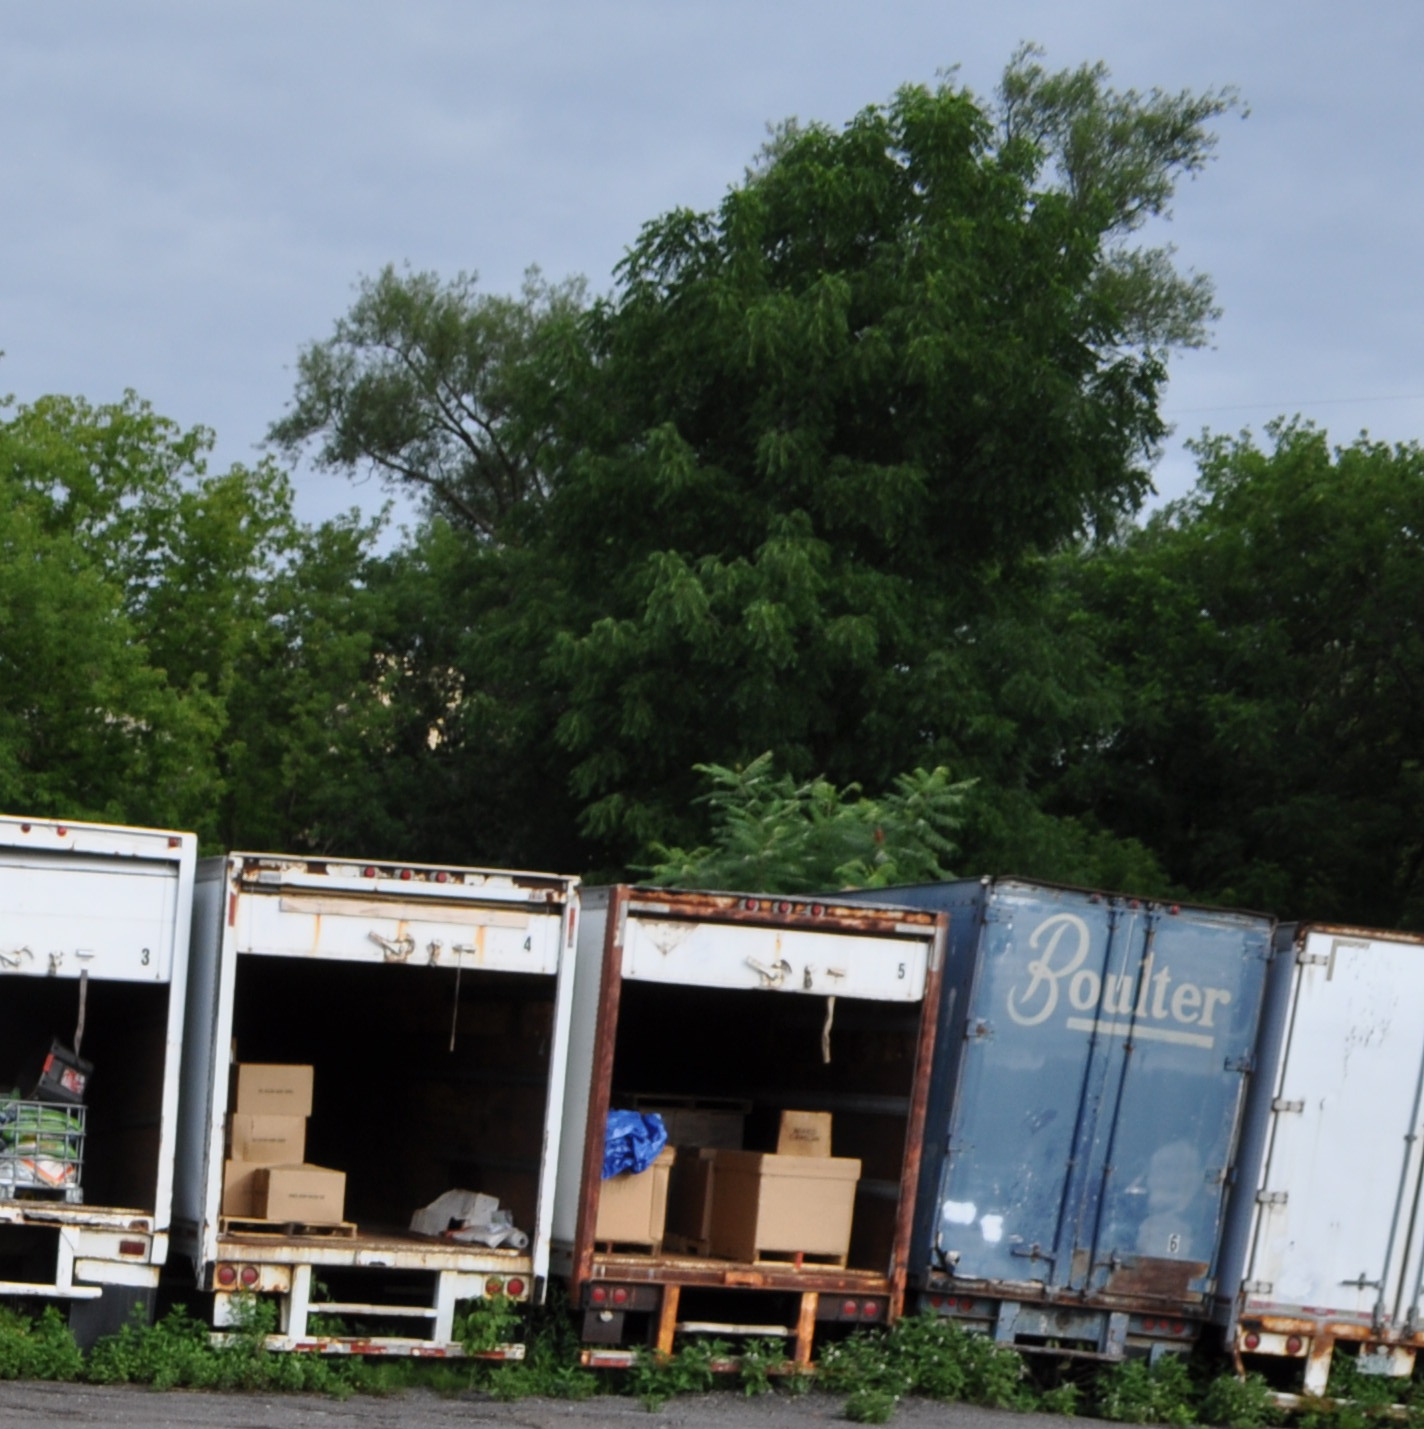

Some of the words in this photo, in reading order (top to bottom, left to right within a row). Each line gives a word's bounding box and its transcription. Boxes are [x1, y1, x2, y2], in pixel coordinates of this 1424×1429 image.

[523, 935, 532, 952] 4
[140, 947, 150, 966] 3
[897, 962, 906, 980] 5
[1006, 912, 1232, 1028] Boulter
[1169, 1233, 1178, 1252] 6
